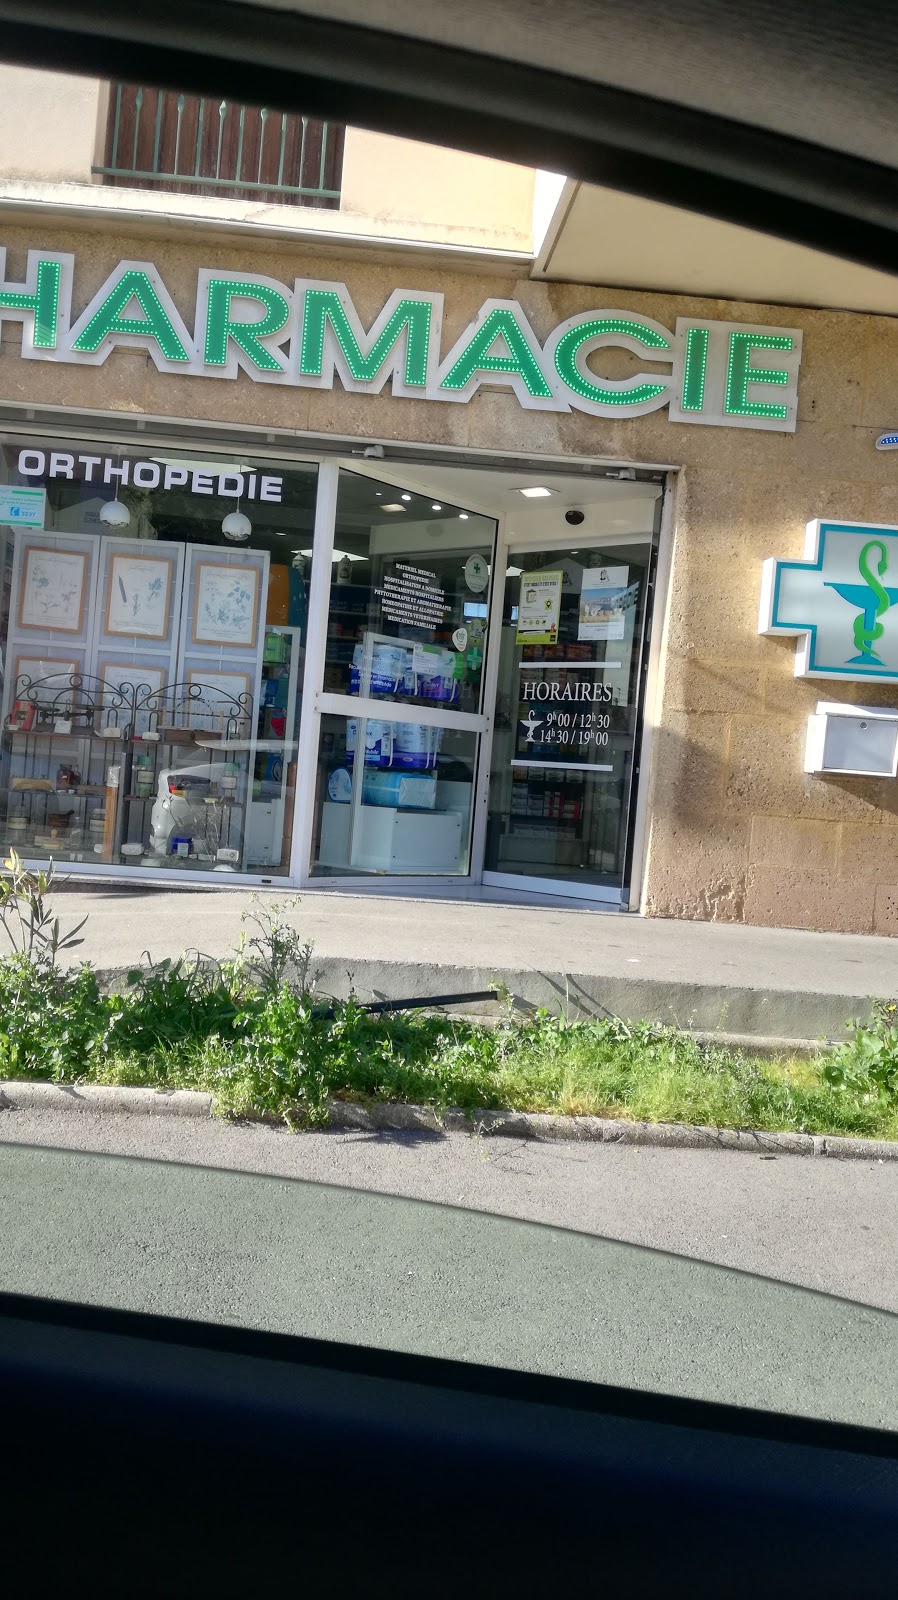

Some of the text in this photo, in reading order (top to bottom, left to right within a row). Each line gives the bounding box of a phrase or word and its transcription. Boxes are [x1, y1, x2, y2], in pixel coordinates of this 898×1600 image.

[18, 450, 283, 502] ORTHOPEDIE
[395, 563, 437, 578] MATERIEL MEDICAL
[402, 573, 429, 584] ORTHOPEDIE
[383, 584, 444, 602] MEDICAMENTS HOSPITALIERS
[384, 576, 422, 589] HOSPITALISATION
[425, 586, 445, 595] DOMICILE
[374, 589, 411, 601] PHYTOTHERAPIE
[417, 599, 452, 611] AROMATHERAPIE
[381, 598, 412, 610] HOMEOPATHIE
[381, 606, 443, 624] MEDICAMENTS VETERINAIRES
[387, 615, 437, 630] MEDICATION FAMILIALE
[522, 681, 612, 702] HORAIRES
